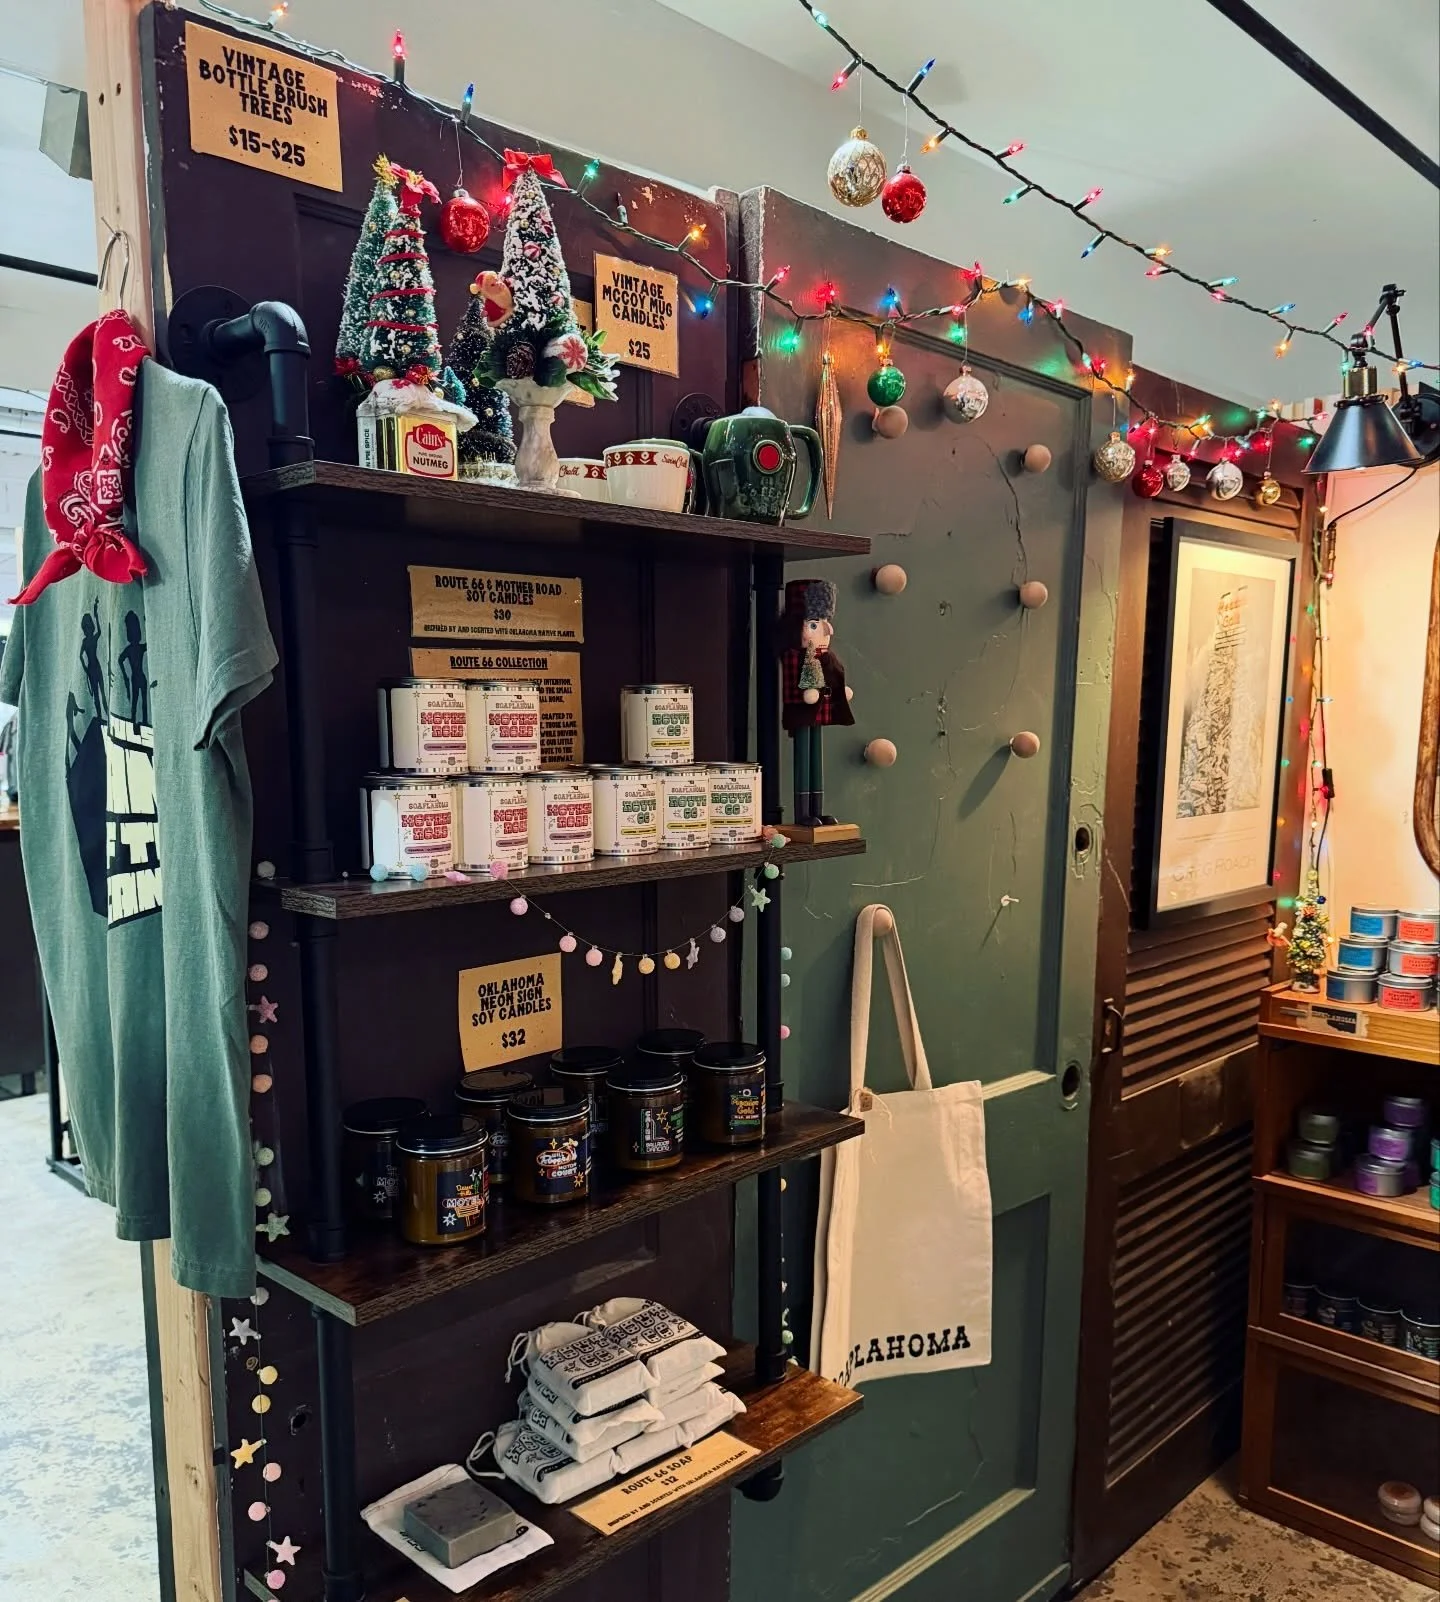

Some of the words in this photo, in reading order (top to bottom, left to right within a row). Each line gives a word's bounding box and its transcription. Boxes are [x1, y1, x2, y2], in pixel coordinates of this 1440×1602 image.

[222, 46, 305, 91] VINTAGE
[199, 58, 270, 99] BOTTLE
[275, 84, 328, 118] BRUSH
[239, 91, 293, 125] TREES
[229, 125, 305, 167] $15-$25
[612, 271, 664, 299] VINTAGE
[602, 284, 646, 309] MCCOY
[650, 300, 673, 317] MUG
[612, 304, 665, 330] CANDLES
[628, 339, 650, 360] $25
[413, 456, 449, 469] NUTMEG
[435, 575, 469, 589] ROUTE
[472, 578, 484, 590] 66
[487, 579, 493, 591] &
[496, 580, 534, 594] MOTHER
[536, 583, 561, 595] ROAD
[466, 590, 486, 602] SOY
[489, 592, 534, 605] CANDLES
[494, 609, 511, 621] $30
[471, 626, 494, 634] SCENTED
[450, 656, 480, 667] ROUTE
[482, 656, 493, 667] 66
[496, 657, 548, 668] COLLECTION
[478, 973, 544, 997] OKLAHOMA
[480, 992, 514, 1011] NEON
[517, 986, 543, 1003] SIGN
[472, 1009, 495, 1027] SOY
[499, 998, 552, 1020] CANDLES
[502, 1029, 526, 1049] $32
[621, 1475, 655, 1495] ROUTE
[653, 1469, 669, 1479] 66
[666, 1455, 693, 1471] SOAP
